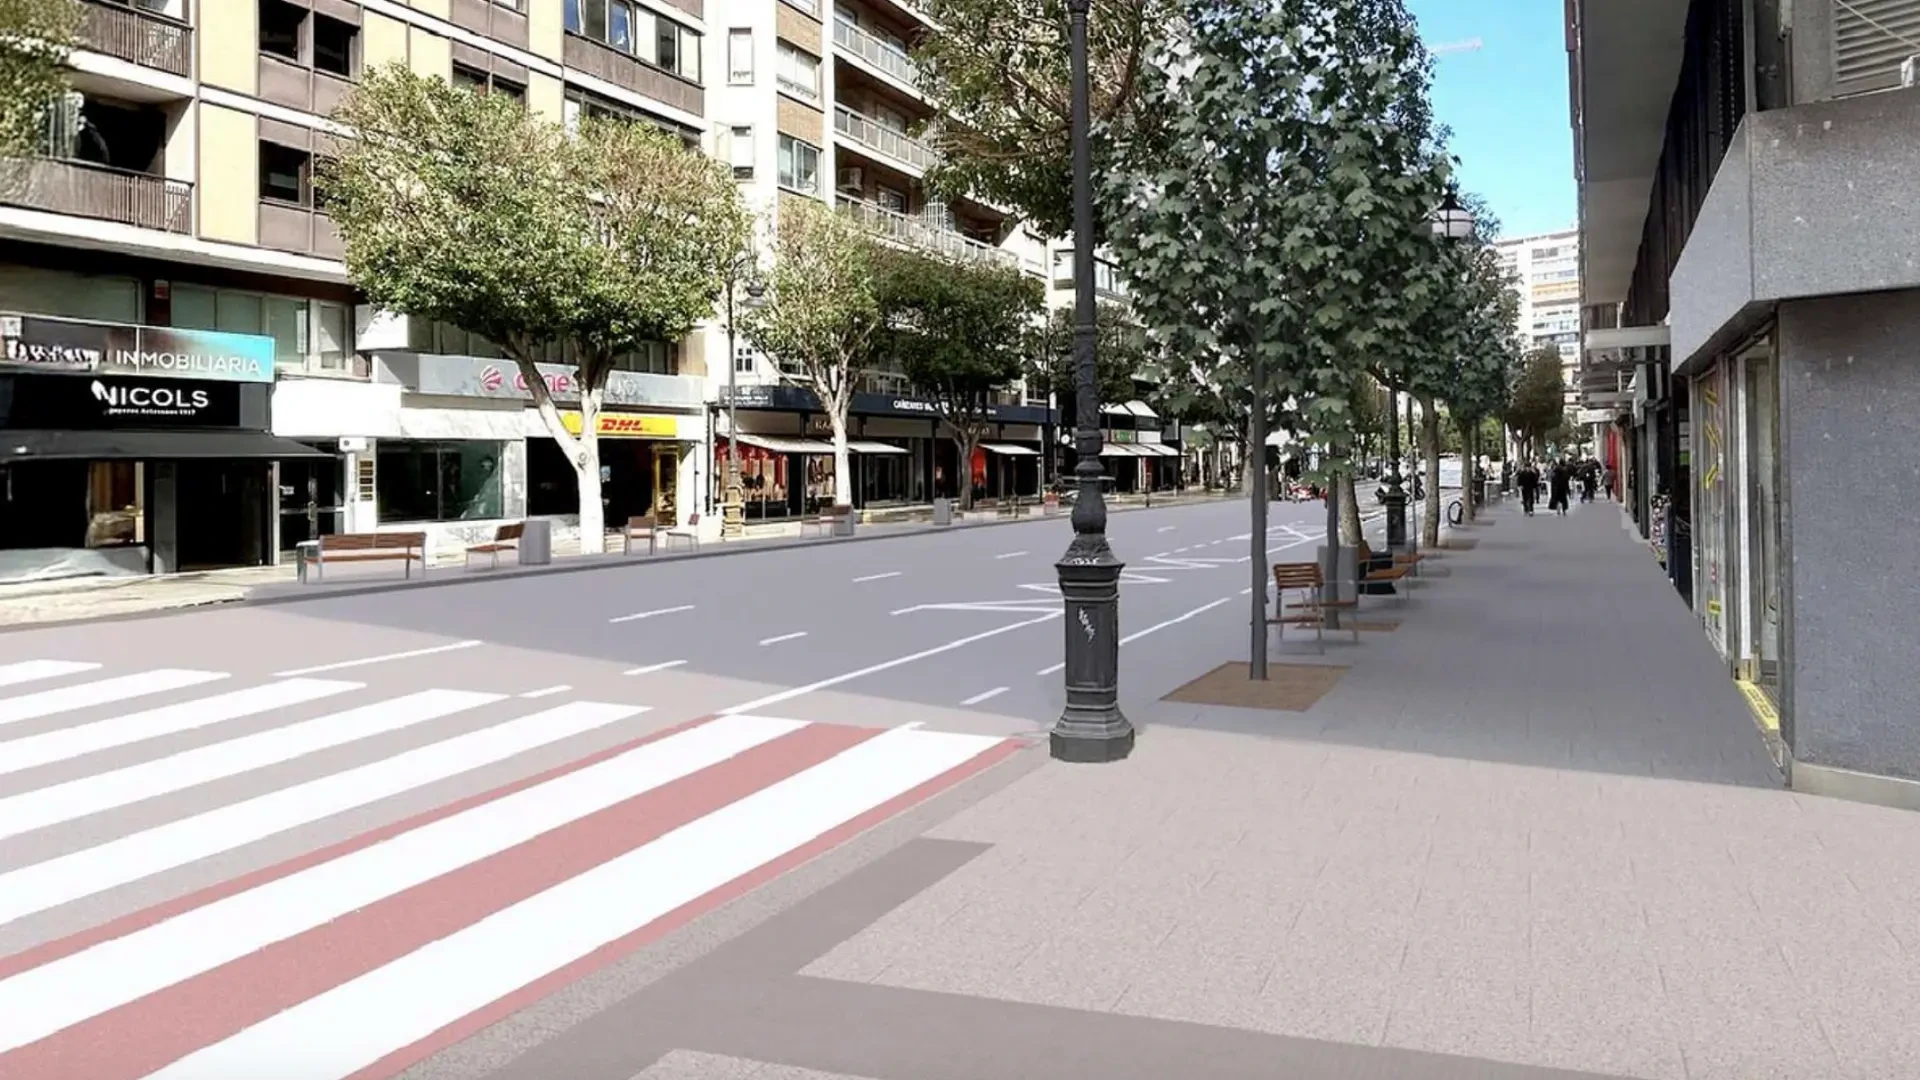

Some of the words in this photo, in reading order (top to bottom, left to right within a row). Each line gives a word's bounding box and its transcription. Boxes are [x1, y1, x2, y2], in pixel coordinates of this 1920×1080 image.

[115, 349, 261, 374] INMOBILIARIA
[91, 380, 209, 408] NICOLS
[601, 418, 643, 431] DHL
